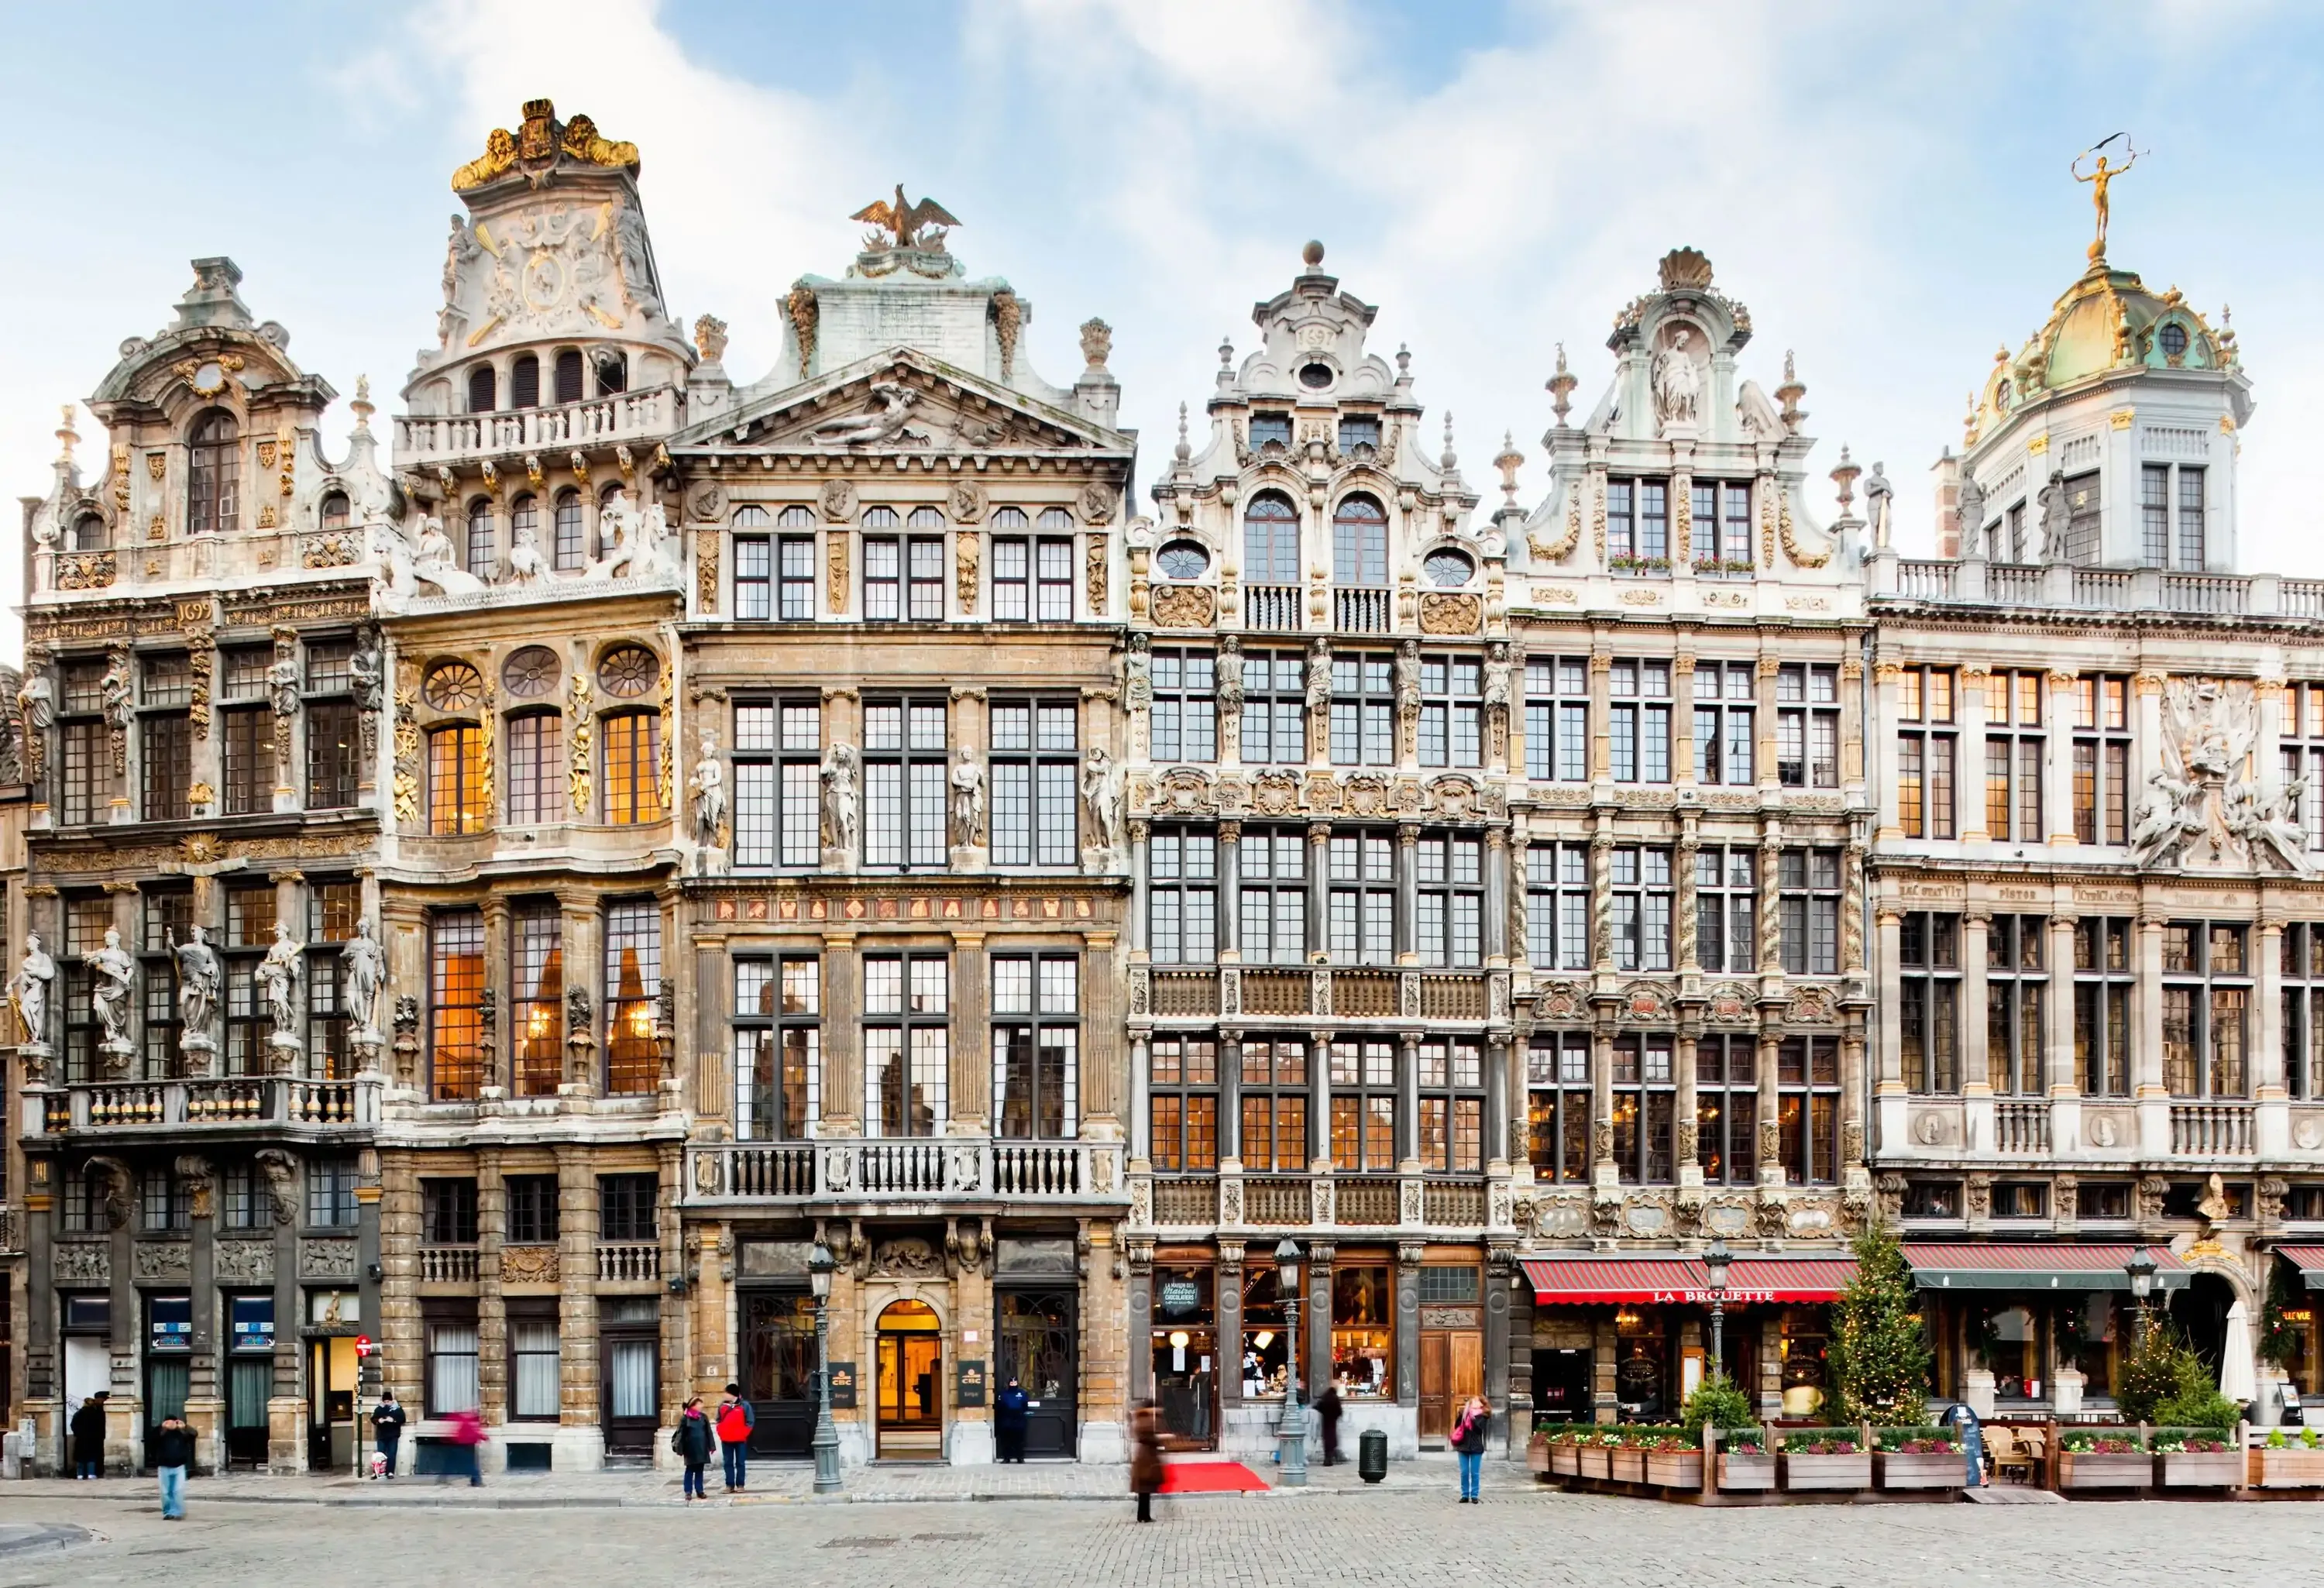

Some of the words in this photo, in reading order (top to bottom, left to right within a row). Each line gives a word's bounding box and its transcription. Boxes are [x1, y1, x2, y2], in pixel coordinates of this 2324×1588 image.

[1298, 329, 1334, 345] 1697
[177, 603, 212, 621] 1699
[1654, 1291, 1676, 1301] LA
[1685, 1291, 1774, 1301] BROUETTE
